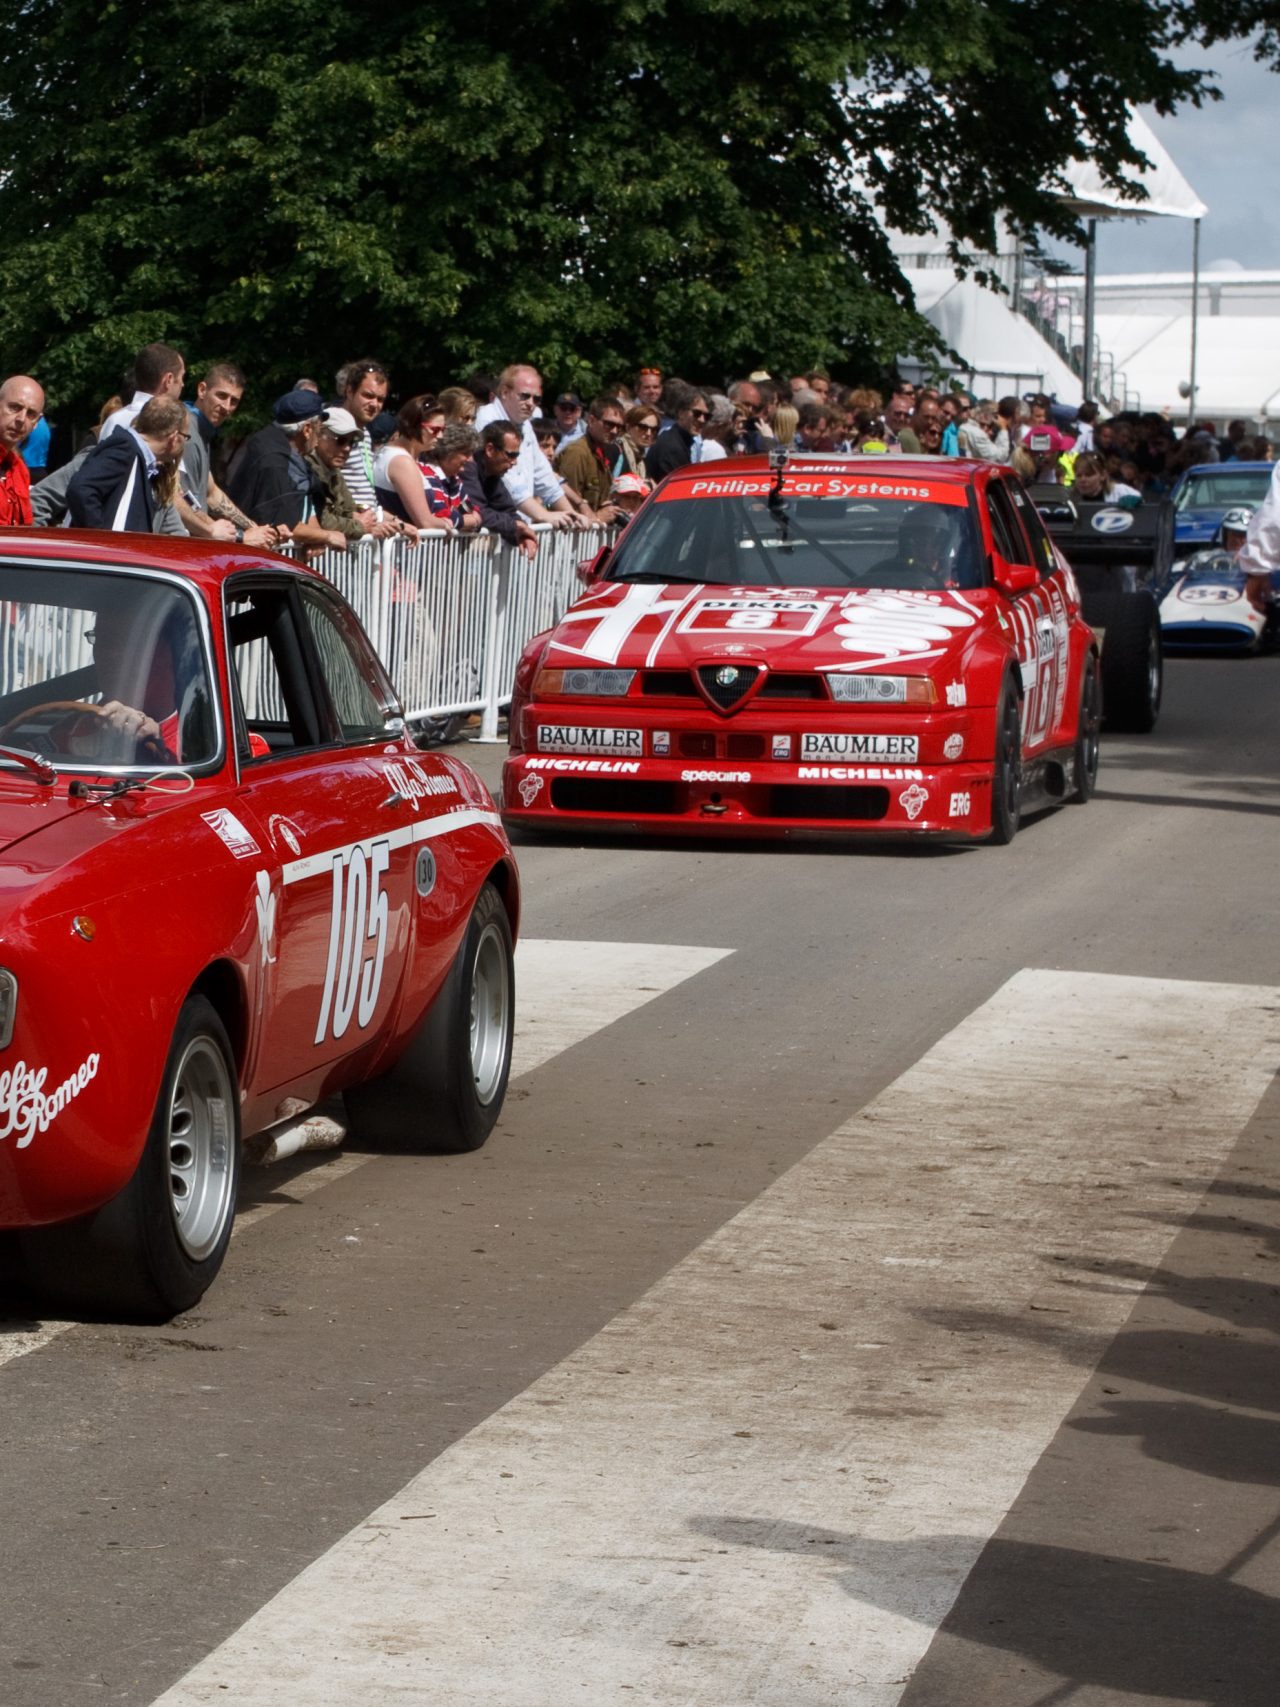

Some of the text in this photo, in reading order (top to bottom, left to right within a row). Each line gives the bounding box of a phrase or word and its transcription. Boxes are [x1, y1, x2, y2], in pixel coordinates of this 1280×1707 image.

[691, 479, 930, 498] Philips Car Systems
[703, 601, 820, 611] DEKRA
[725, 610, 779, 630] 8
[540, 726, 641, 748] BÄUMLER
[804, 734, 917, 755] BÄUMLER
[525, 758, 640, 773] MICHELIN
[857, 754, 916, 762] fashion
[798, 767, 923, 780] MICHELIN
[949, 792, 970, 817] ERG
[314, 839, 390, 1046] 105
[13, 1053, 100, 1149] Romeo
